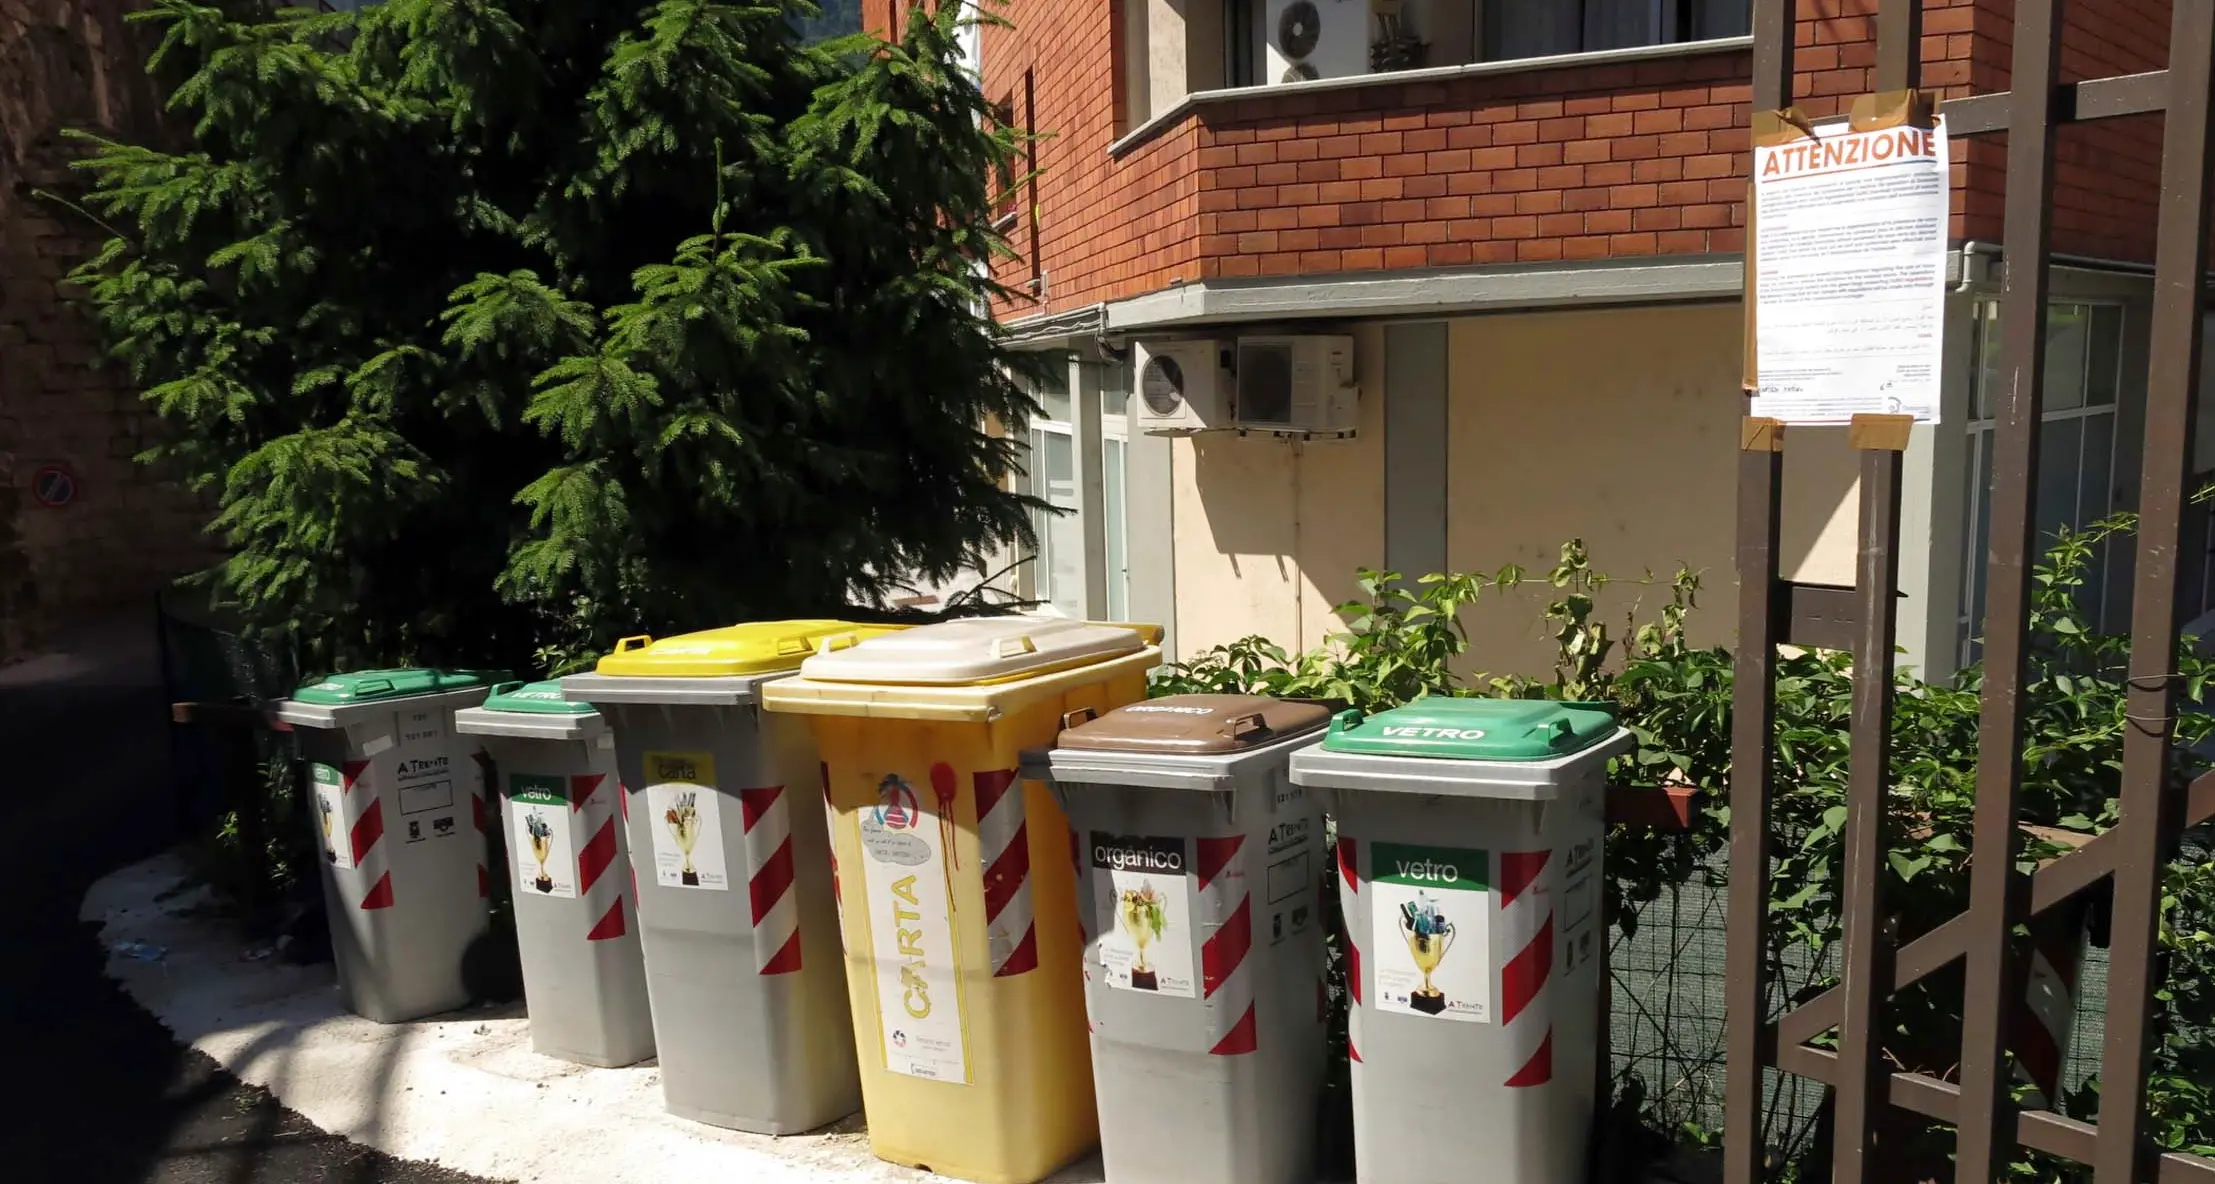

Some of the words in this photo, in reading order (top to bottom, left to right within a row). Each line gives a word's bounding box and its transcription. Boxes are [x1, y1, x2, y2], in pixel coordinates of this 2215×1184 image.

[1762, 131, 1937, 176] ATTENZIONE
[1382, 726, 1485, 740] VETRO
[520, 784, 552, 800] vetro
[1095, 845, 1182, 872] organico
[1396, 858, 1459, 883] vetro
[891, 875, 932, 1018] CARTA
